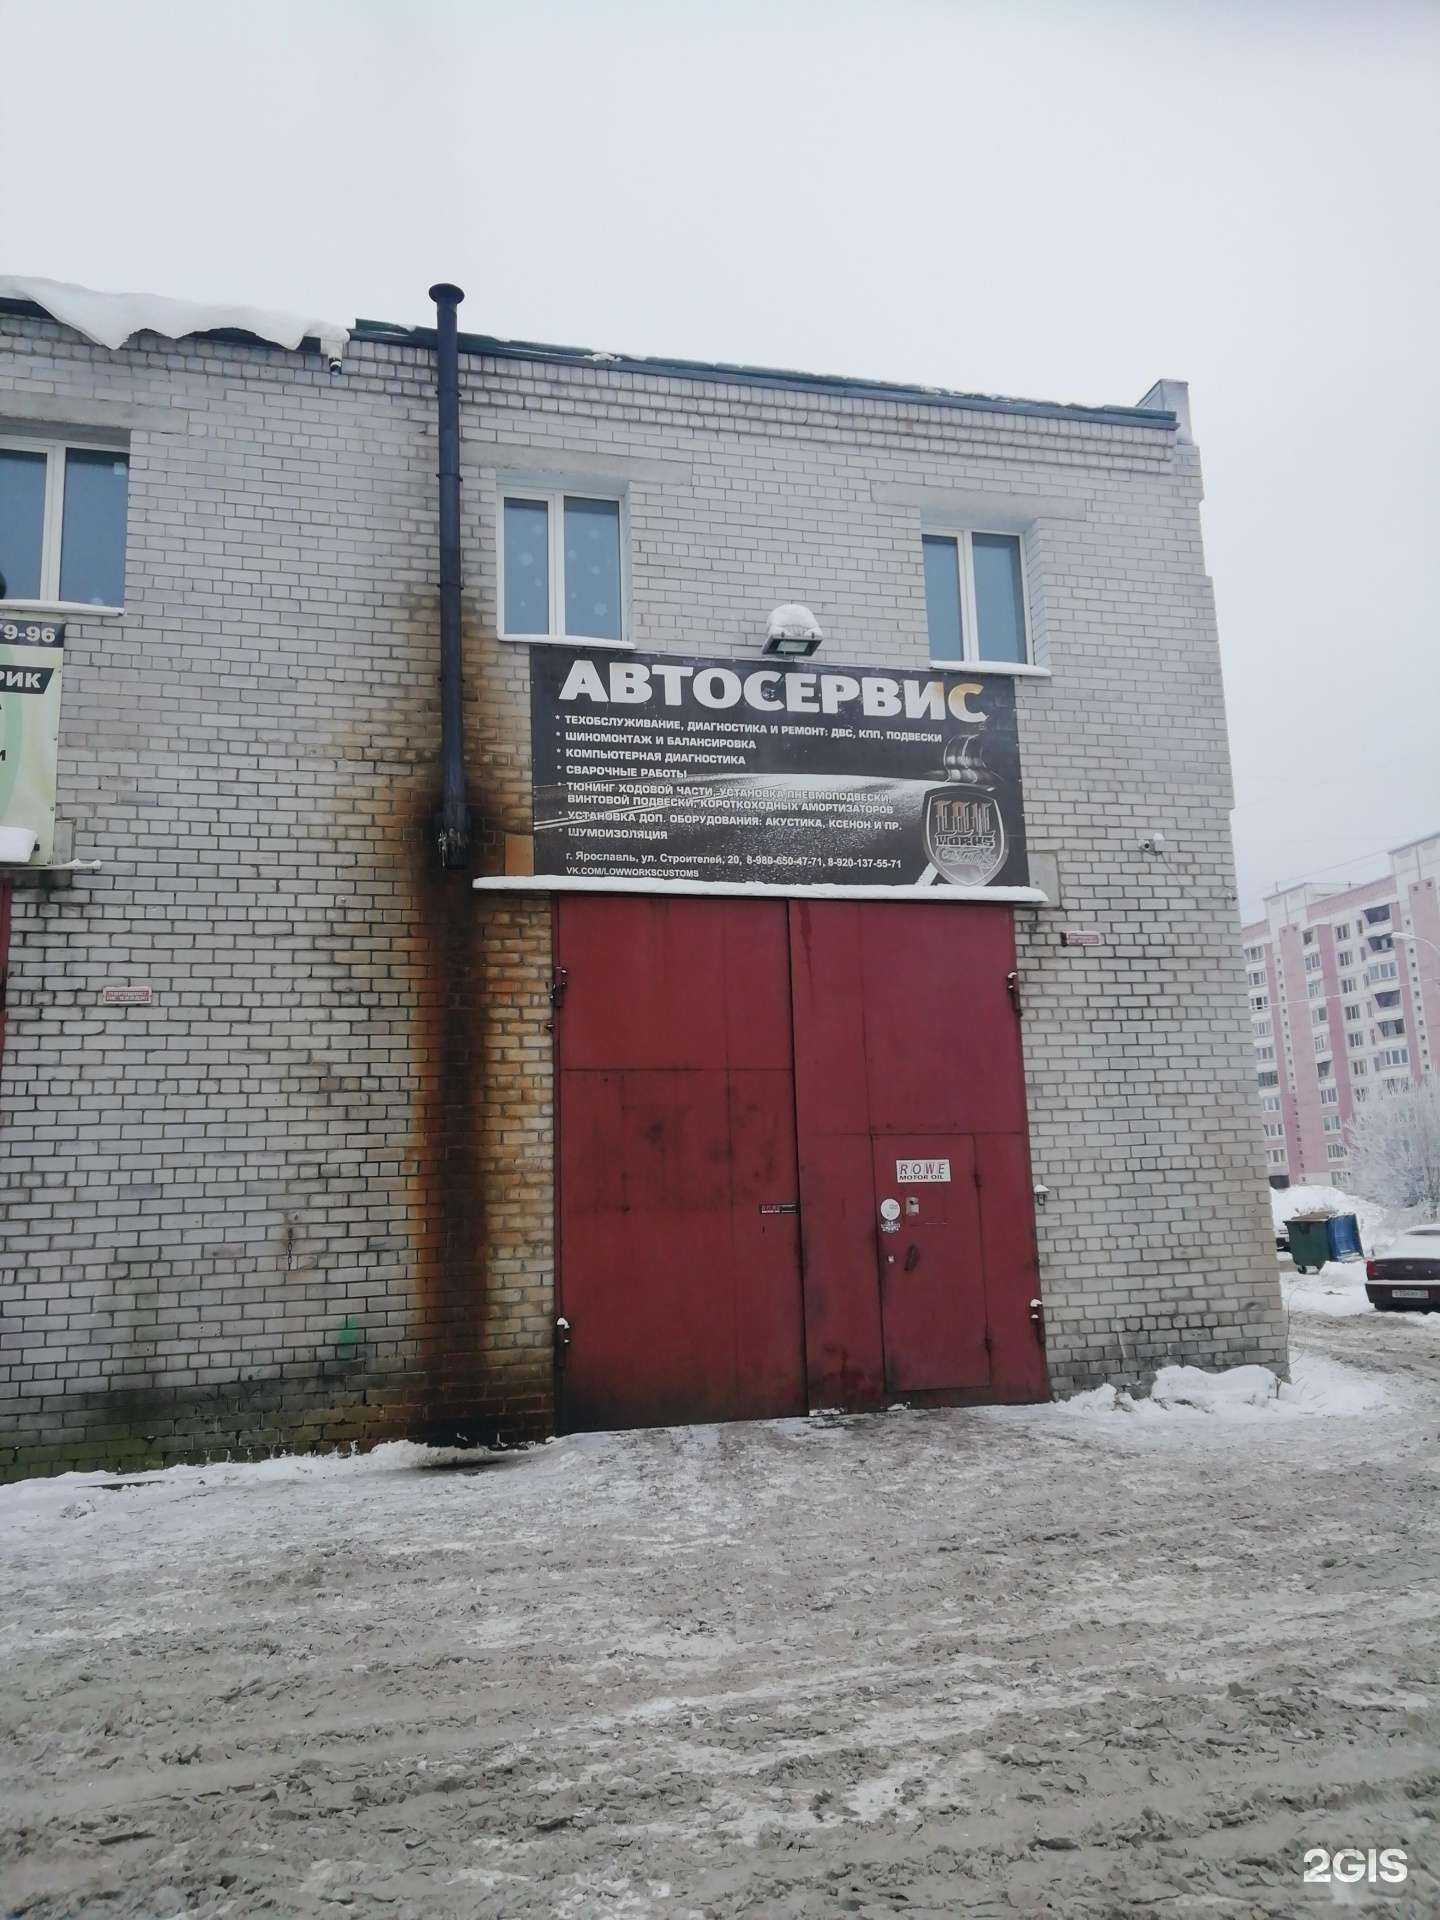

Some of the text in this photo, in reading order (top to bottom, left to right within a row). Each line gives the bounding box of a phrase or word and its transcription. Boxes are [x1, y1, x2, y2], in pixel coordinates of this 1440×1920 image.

[0, 623, 56, 643] 9-96
[558, 659, 988, 723] АВТОСЕРВИС
[565, 715, 943, 743] ТЕХОБСЛУЖИВАНИЕ, ДИАГНОСТИКА И РЕМОНТ: ДВС, КПП, ПОДВЕСКИ
[565, 732, 757, 749] ШИНОМОНТАЖ И БАЛАНСИРОВКА
[566, 748, 746, 765] КОМПЬЮТЕРНАЯ ДИАГНОСТИКА
[566, 765, 687, 779] СВАРОЧНЫЕ РАБОТЫ
[566, 782, 892, 803] ТЮНИНГ ХОДОВОЙ ЧАСТИ, УСТАНОВКА ПНЕВМОПОДВЕСКИ,
[567, 794, 894, 814] ВИНТОВОЙ ПОДВЕСКИ, КОРОТКОХОДНЫХ АМОРТИЗАТОРОВ
[567, 811, 902, 831] УСТАНОВКА ДОП. ОБОРУДОВАНИЯ: АКУСТИКА, КСЕНОН И ПР.
[568, 827, 668, 840] ШУМОИЗОЛЯЦИЯ
[565, 852, 573, 860] г.
[575, 851, 639, 863] Ярославль,
[641, 854, 657, 864] ул.
[660, 853, 725, 865] Строителей,
[727, 855, 742, 866] 20,
[827, 857, 902, 869] 8-920-137-55-71
[566, 866, 699, 878] VK.COM/LOWWORKSCUSTOMS
[900, 1162, 945, 1175] ROWE
